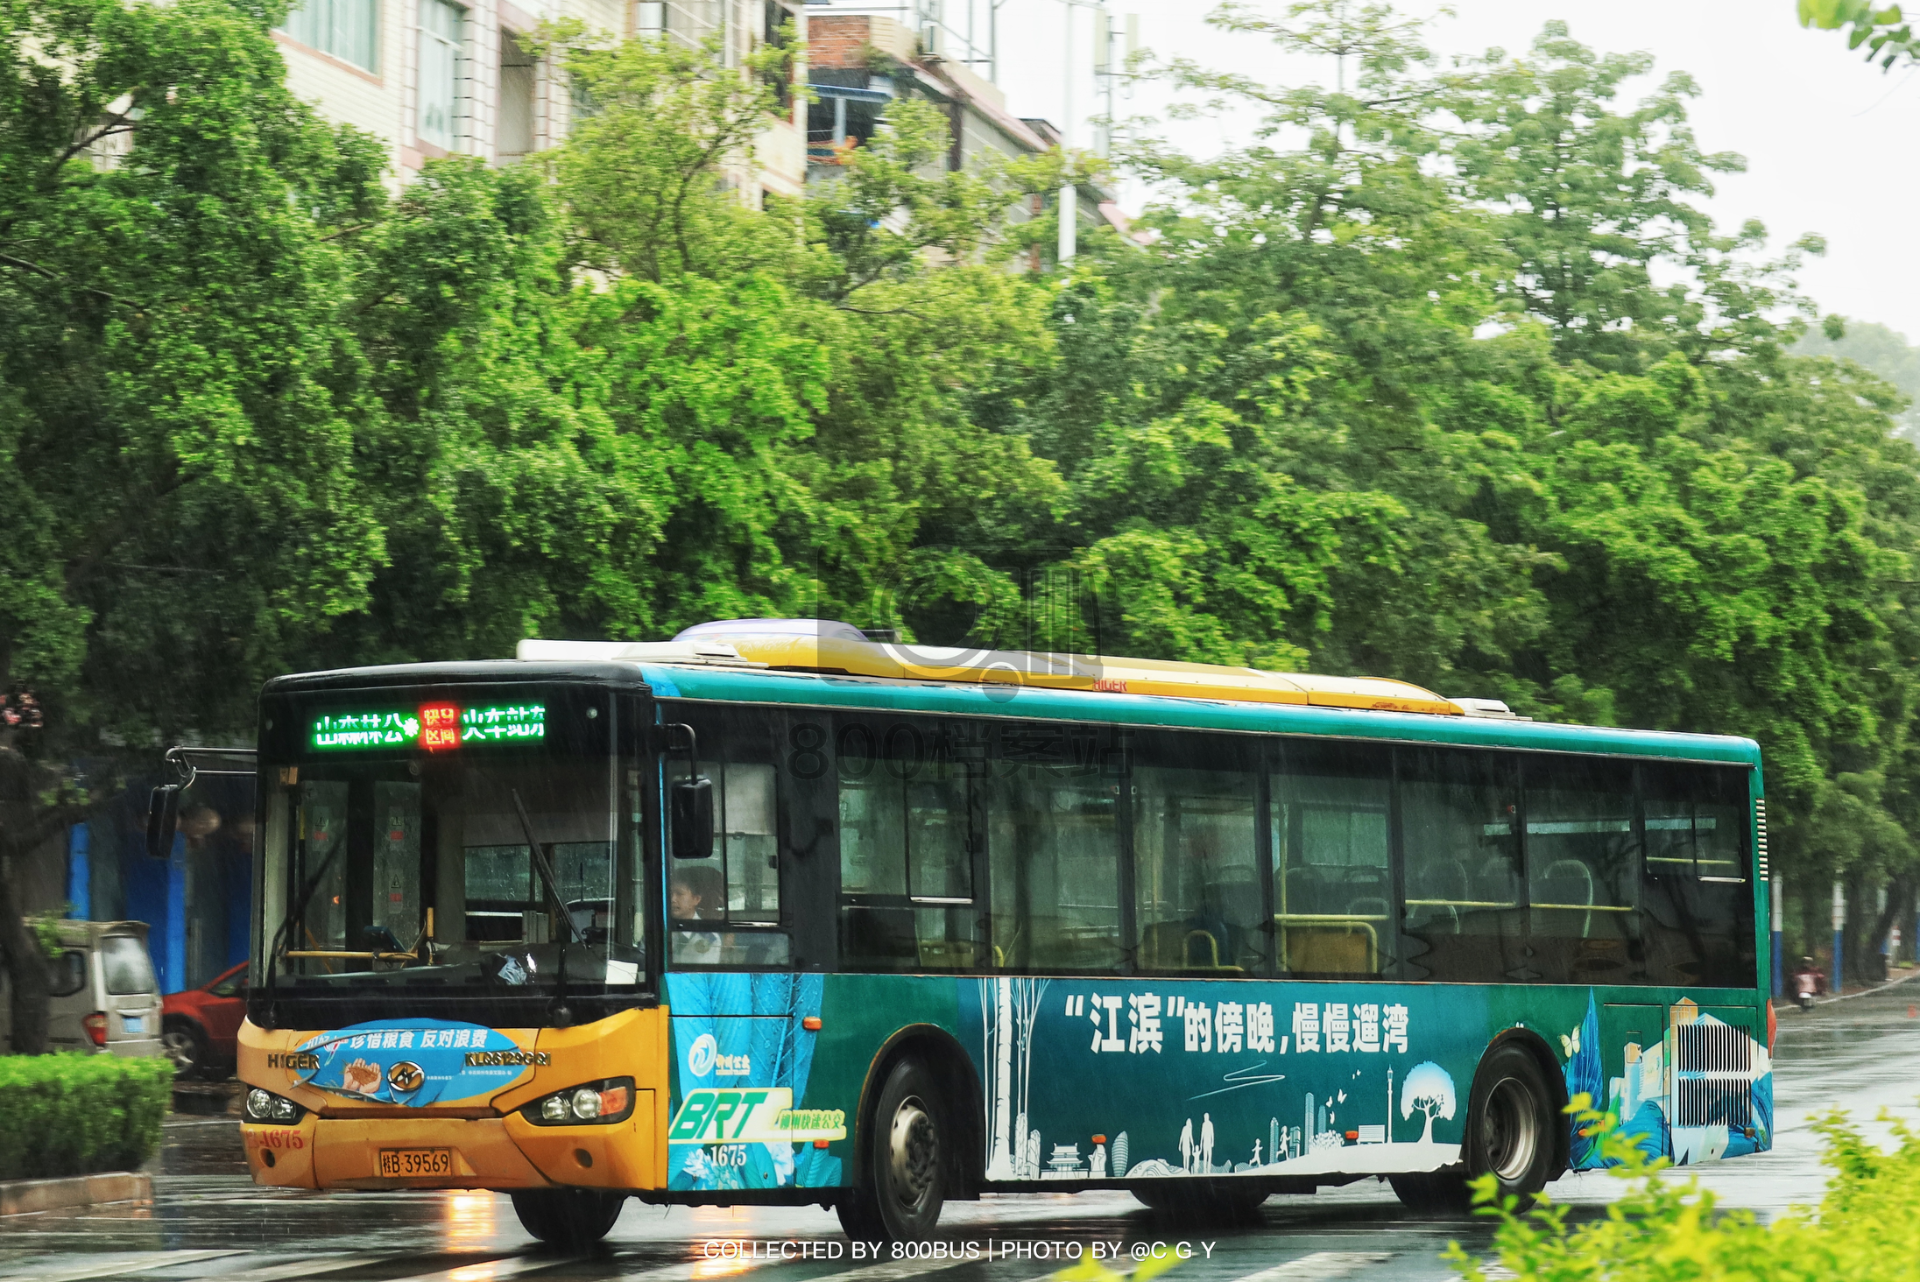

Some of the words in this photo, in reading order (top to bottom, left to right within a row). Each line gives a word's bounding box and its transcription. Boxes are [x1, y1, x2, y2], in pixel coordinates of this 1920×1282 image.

[426, 728, 455, 745] 区间
[349, 1030, 415, 1049] 珍惜粮食
[420, 1030, 488, 1048] 反对浪费
[267, 1053, 320, 1070] HIGER
[669, 1091, 769, 1139] BRT
